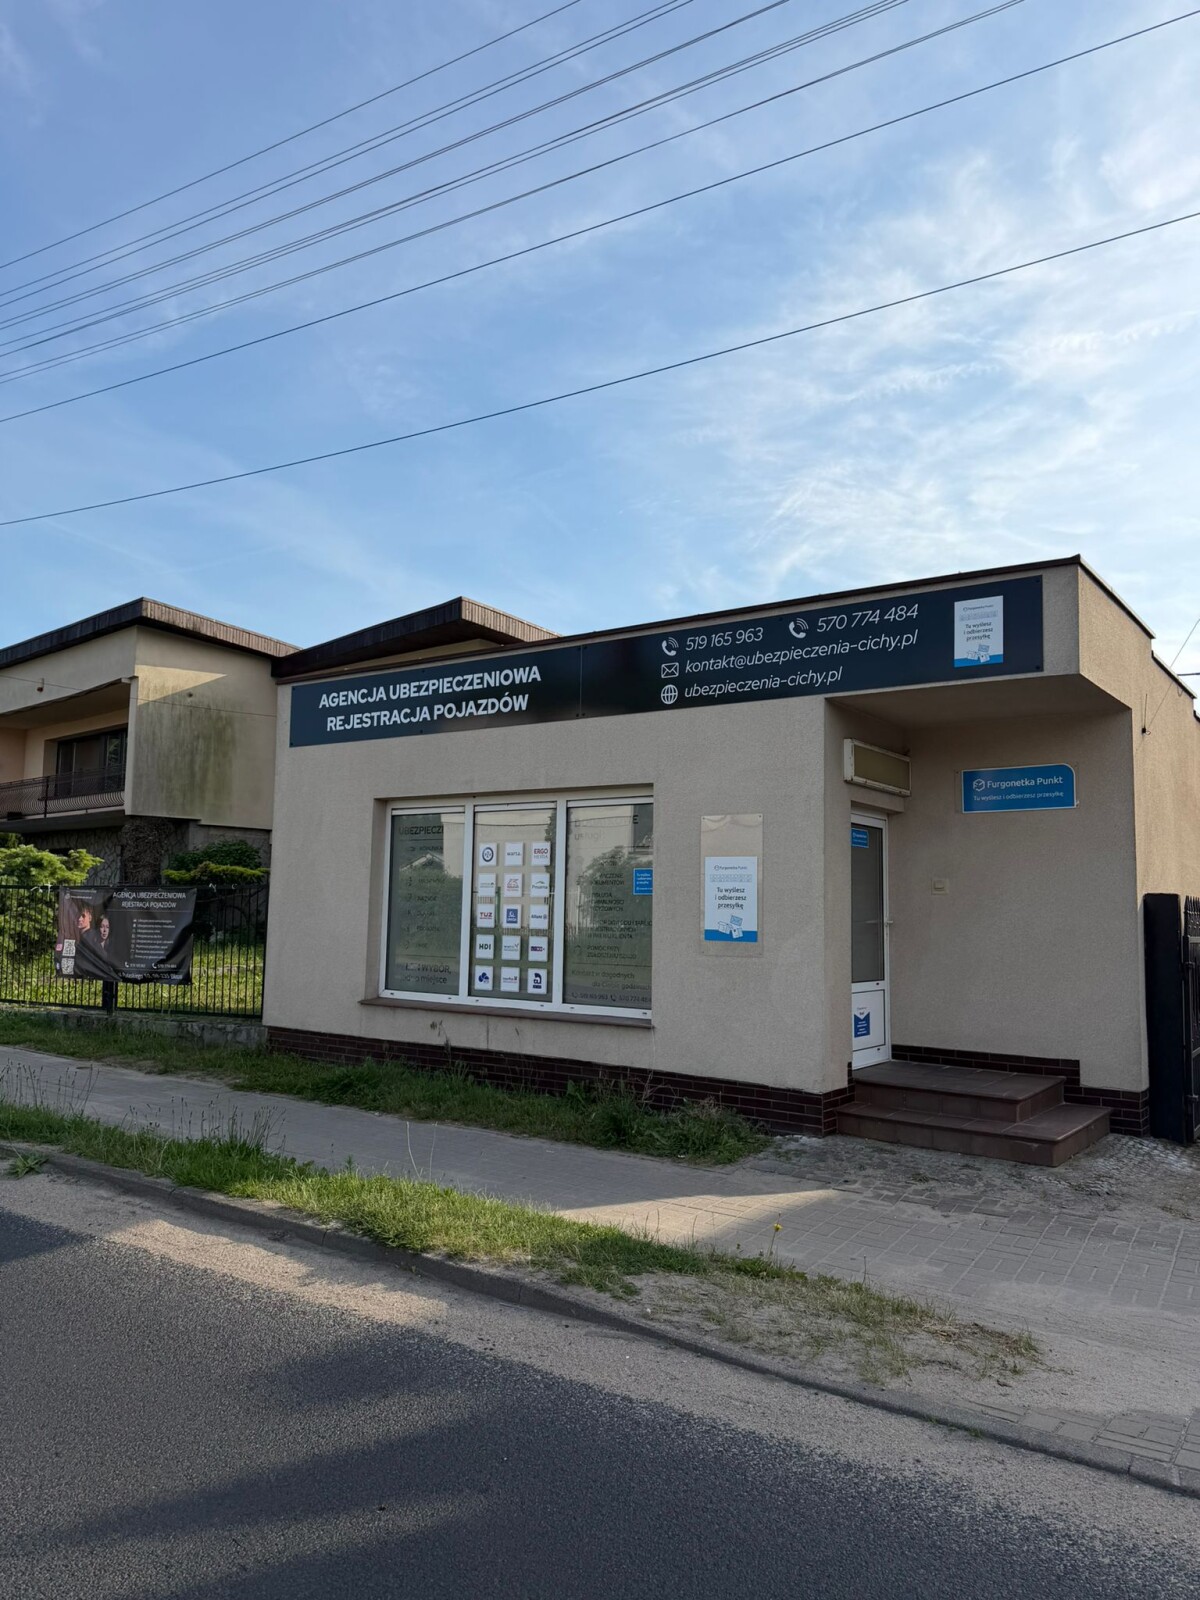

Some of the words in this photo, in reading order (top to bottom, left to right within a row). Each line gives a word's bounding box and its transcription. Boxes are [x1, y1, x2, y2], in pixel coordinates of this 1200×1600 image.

[817, 614, 848, 632] 570
[852, 609, 882, 627] 774
[884, 603, 919, 621] 484
[686, 636, 709, 651] 519
[711, 632, 732, 647] 165
[736, 627, 763, 643] 963
[686, 629, 919, 674] kontakt@ubezpieczenia-cichy.pl
[319, 686, 387, 709] AGENCJA
[389, 665, 542, 700] UBEZPIECZENIOWA
[684, 666, 843, 699] ubezpieczenia-cichy.pl
[326, 705, 431, 732] REJESTRACJA
[433, 691, 530, 720] POJAZDÓW
[987, 778, 1036, 790] Furgonetka
[1036, 776, 1064, 786] Punkt
[981, 794, 1002, 802] wyślesz
[1036, 791, 1065, 799] przesyłkę
[113, 891, 136, 900] AGENCJA
[137, 891, 187, 900] UBEZPIECZENIOWA
[724, 886, 745, 894] wyślesz
[121, 900, 149, 909] REJESTRACJA
[150, 900, 177, 909] POJAZDÓW
[718, 902, 744, 910] przesyłkę
